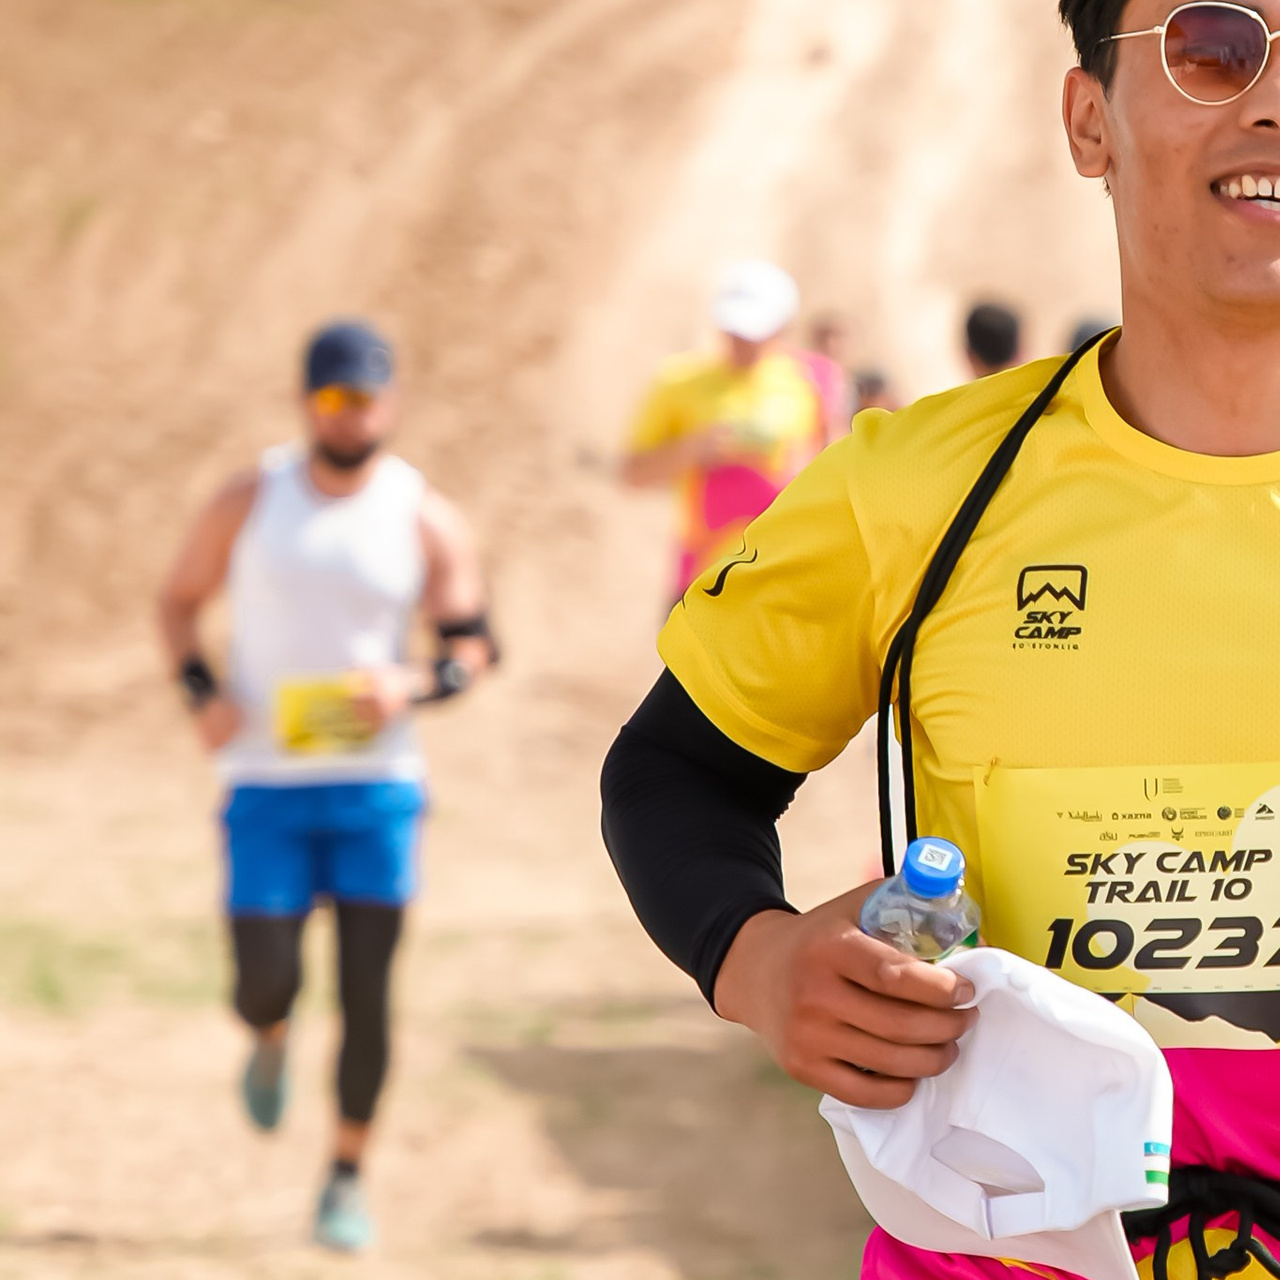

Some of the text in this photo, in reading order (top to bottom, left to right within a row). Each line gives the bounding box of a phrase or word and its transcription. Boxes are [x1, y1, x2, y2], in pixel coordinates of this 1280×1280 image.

[1023, 611, 1073, 624] SKY
[1014, 626, 1081, 639] CAMP
[1064, 849, 1273, 875] SKY CAMP
[1084, 878, 1253, 904] TRAIL 10
